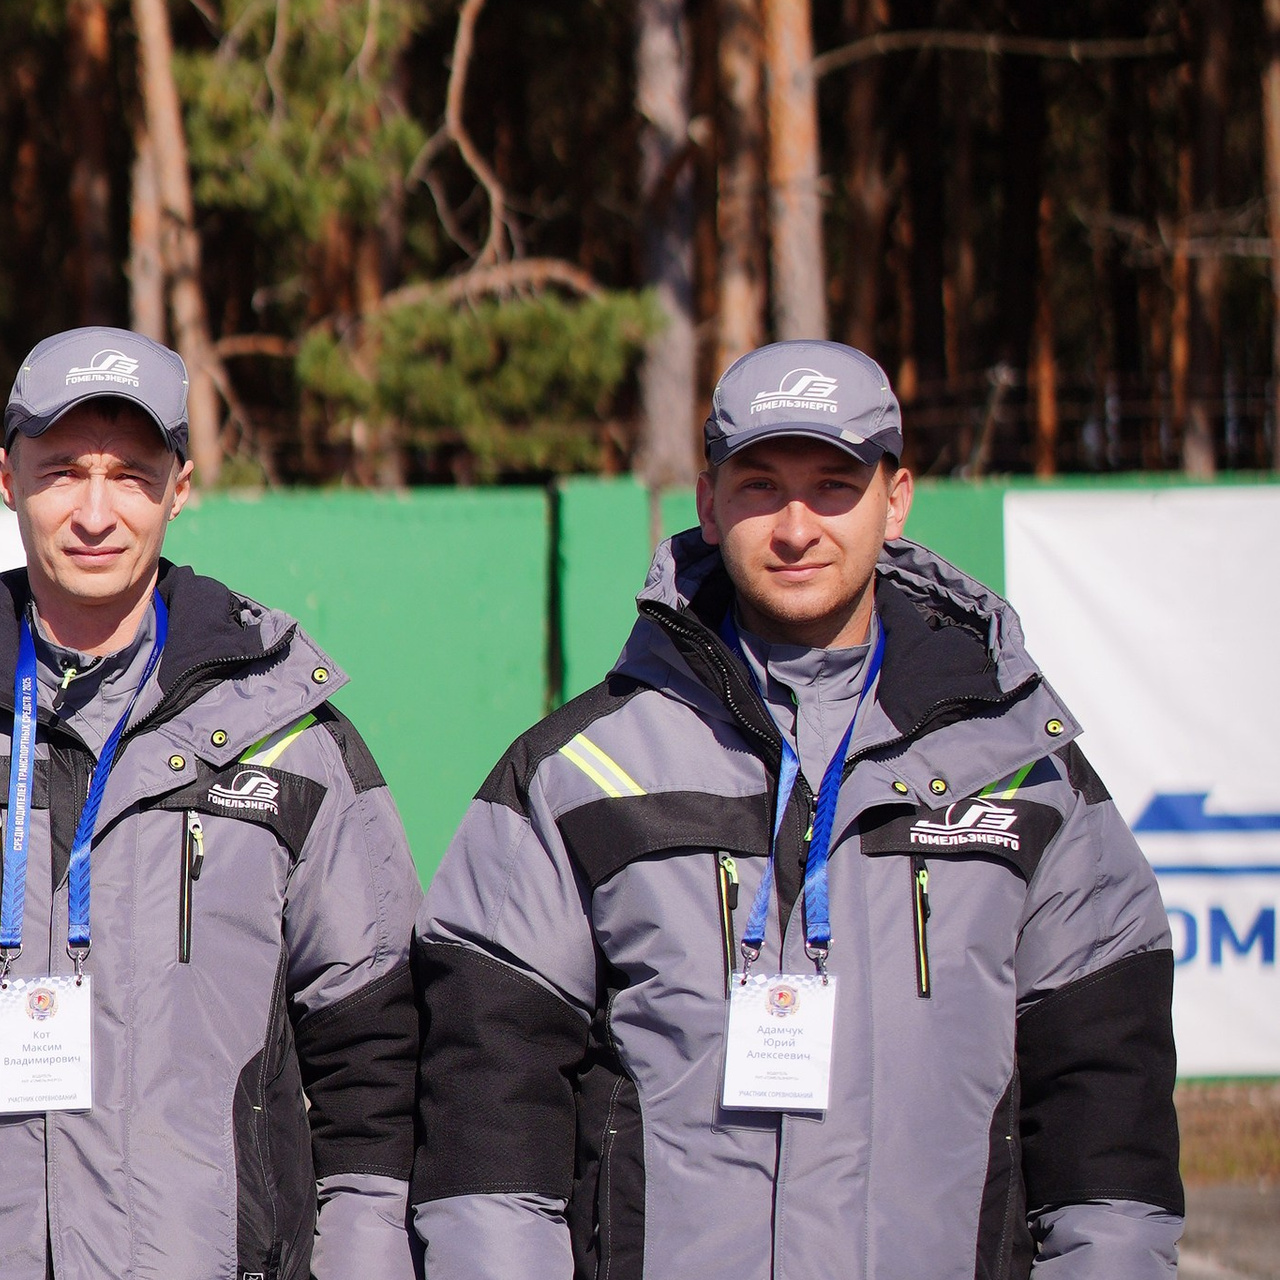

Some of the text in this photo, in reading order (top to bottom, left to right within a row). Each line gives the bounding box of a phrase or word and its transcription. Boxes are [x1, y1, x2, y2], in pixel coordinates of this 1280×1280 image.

[65, 374, 139, 387] ГОМЕЛЬЭНЕРГО
[750, 400, 838, 415] ГОМЕЛЬЭНЕРГО
[18, 724, 31, 781] ТРАНСПОРТНЫХ
[207, 793, 279, 815] ГОМЕЛЬЭНЕРГО
[13, 828, 25, 851] СРЕДИ
[910, 832, 1020, 851] ГОМЕЛЬЭНЕРГО
[33, 1031, 51, 1039] Кот
[757, 1025, 804, 1036] Адамчук
[22, 1043, 62, 1052] Максим
[763, 1037, 796, 1049] Юрий
[4, 1055, 81, 1068] Владимирович
[746, 1050, 811, 1061] Алексеевич
